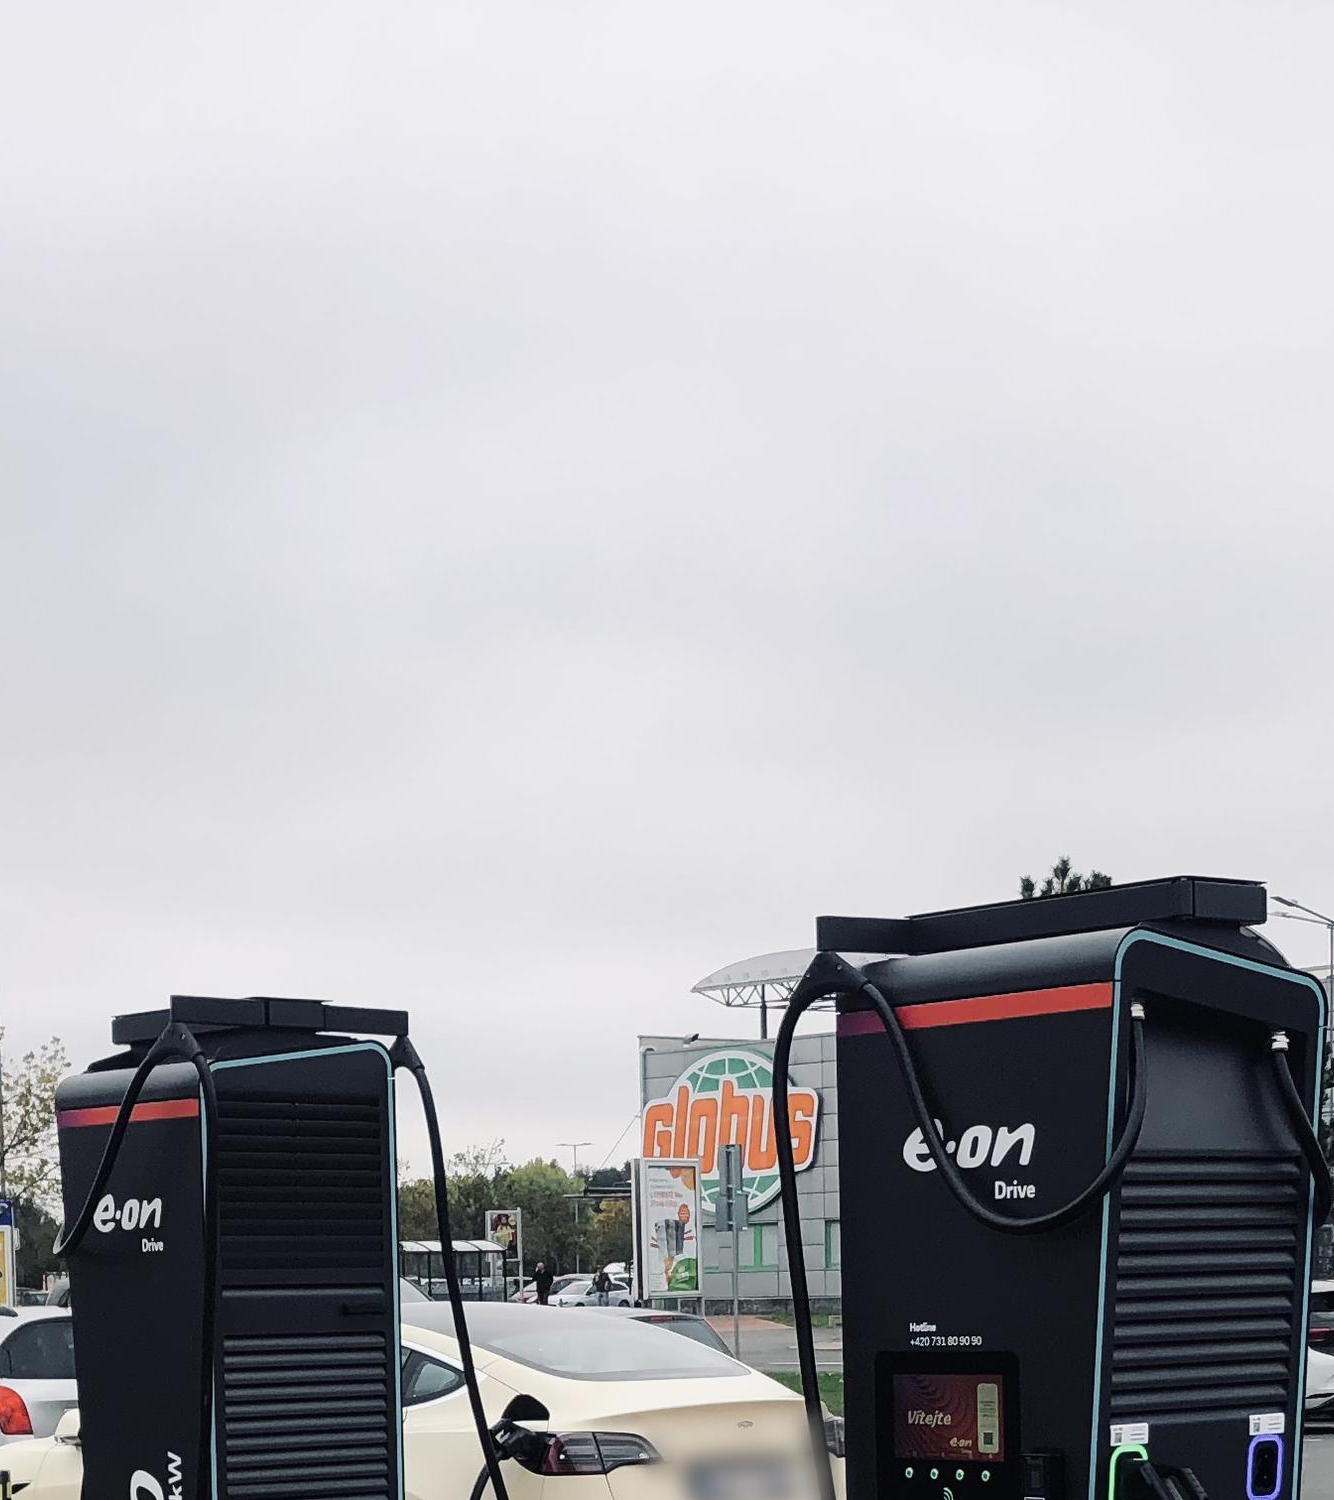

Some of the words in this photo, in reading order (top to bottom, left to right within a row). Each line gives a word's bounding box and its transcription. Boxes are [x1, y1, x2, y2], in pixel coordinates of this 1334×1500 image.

[994, 1179, 1036, 1199] Drive
[141, 1237, 164, 1253] Drive
[910, 1336, 930, 1347] +420
[931, 1336, 946, 1346] 731
[947, 1336, 958, 1346] 80
[959, 1336, 970, 1346] 90
[971, 1335, 983, 1346] 90
[907, 1410, 952, 1428] Vítejte
[167, 1451, 183, 1500] kW
